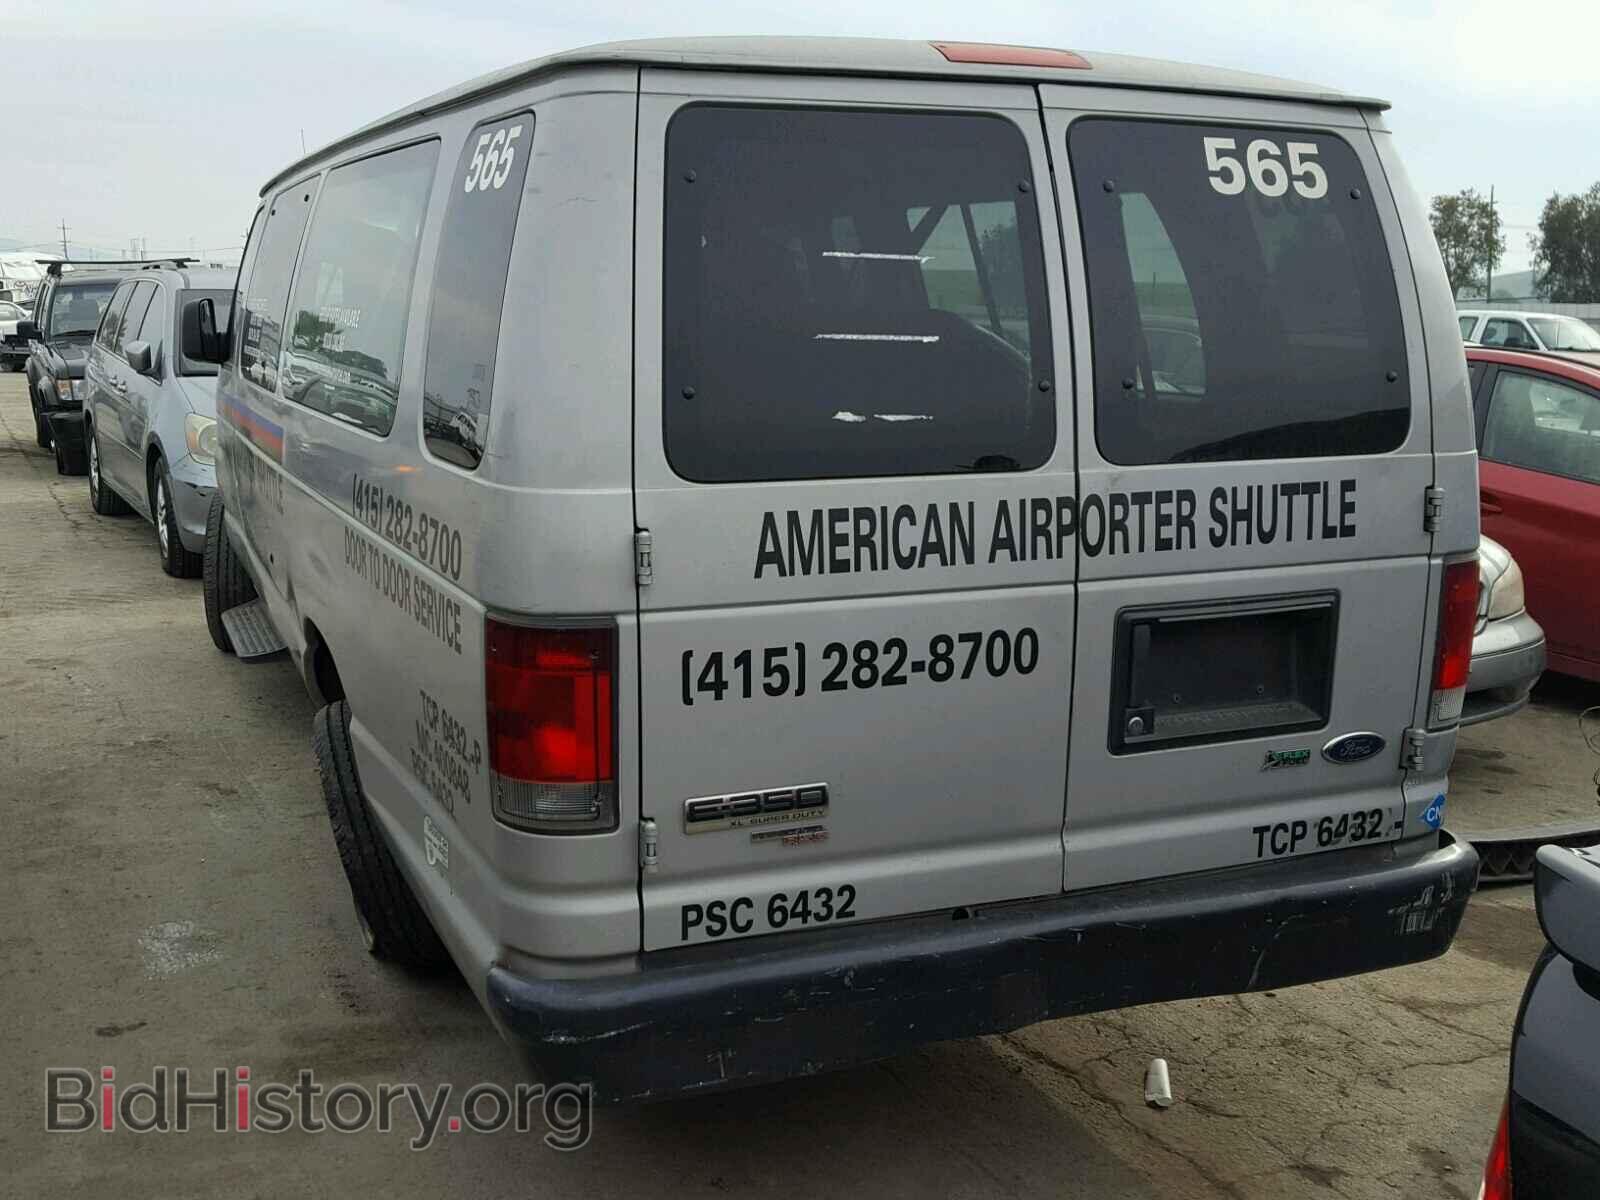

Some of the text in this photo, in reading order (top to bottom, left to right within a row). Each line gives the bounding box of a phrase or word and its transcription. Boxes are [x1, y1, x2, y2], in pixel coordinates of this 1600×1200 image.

[464, 125, 523, 192] 565
[1203, 136, 1329, 199] 565
[352, 473, 383, 536] (415)
[385, 494, 462, 582] 282-8700
[753, 479, 1357, 579] AMERICAN AIRPORTER SHUTTLE
[344, 525, 463, 656] DOOR TO DOOR SERVICE
[681, 627, 1040, 706] (415) 282-8700
[420, 688, 440, 733] TCP
[687, 785, 826, 822] E-350
[1252, 820, 1307, 859] TCP
[681, 884, 857, 941] PSC 6432
